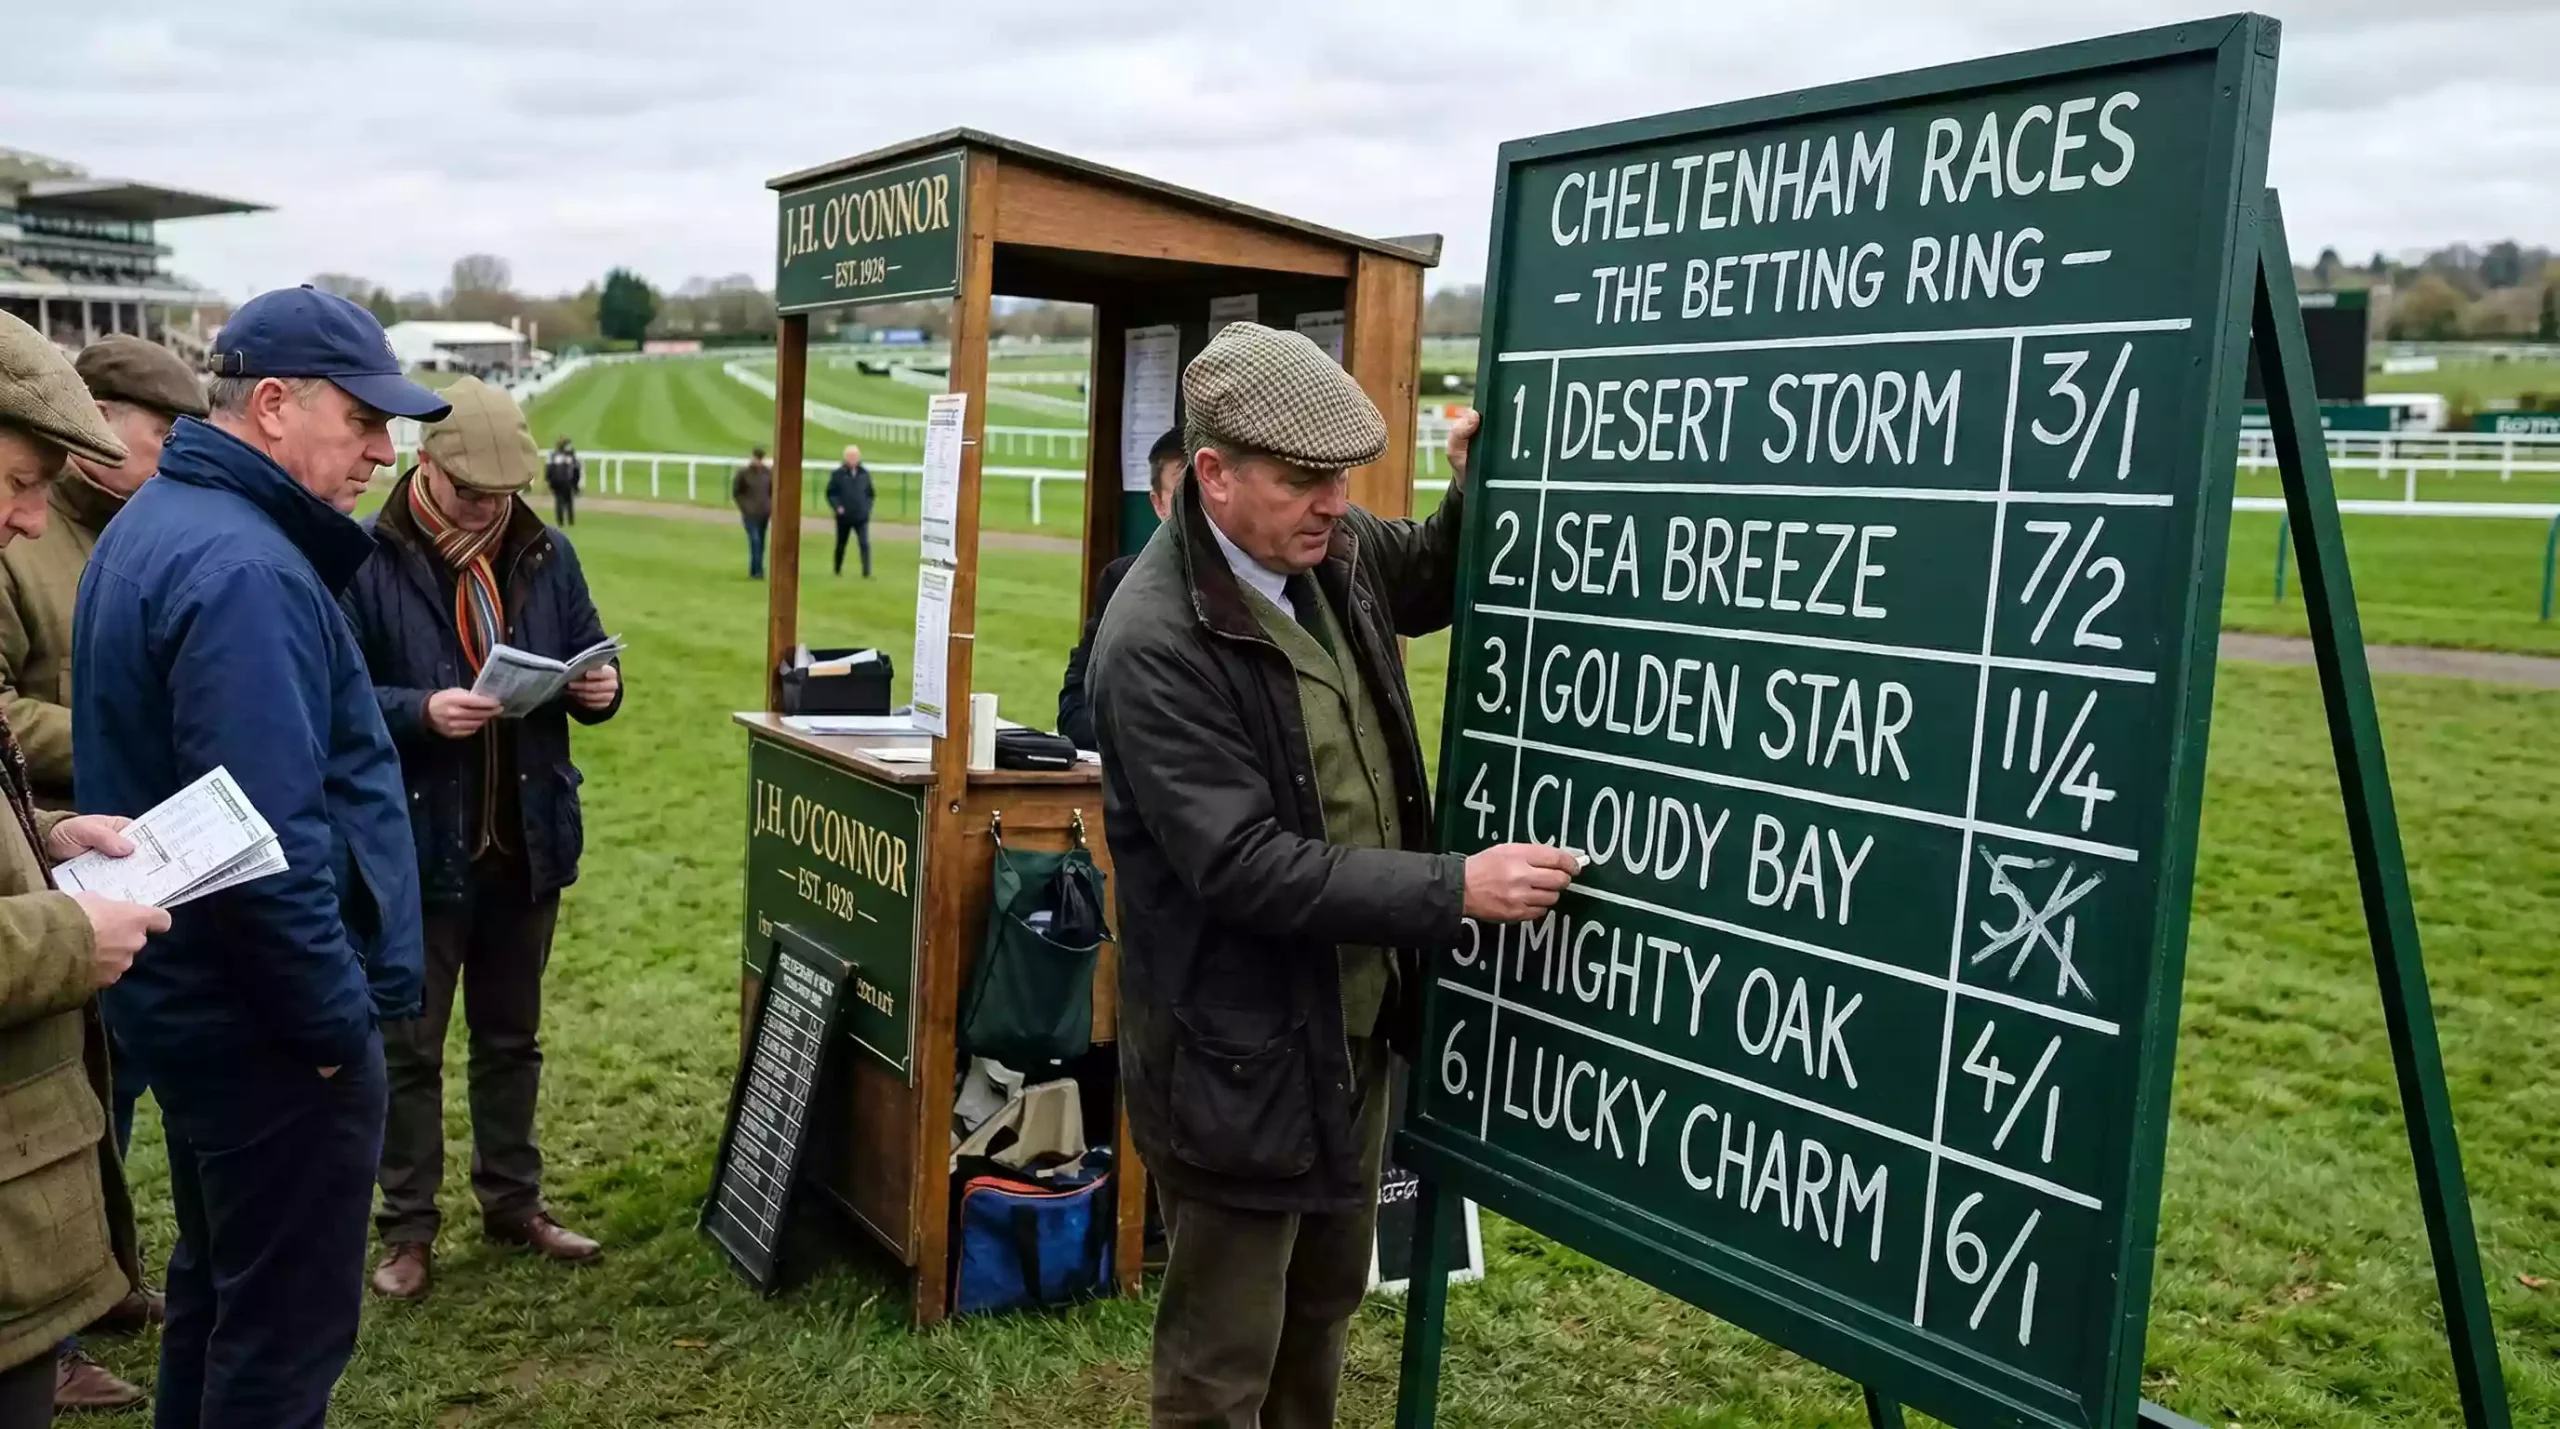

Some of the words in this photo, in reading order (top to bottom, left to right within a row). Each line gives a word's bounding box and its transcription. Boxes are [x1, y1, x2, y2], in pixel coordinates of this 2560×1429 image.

[784, 203, 819, 268] J.H.
[823, 173, 951, 251] O'CONNOR
[1551, 126, 1895, 247] CHELTENHAM
[1919, 91, 2141, 207] RACES
[834, 259, 858, 289] EST.
[860, 256, 885, 286] 1928
[1592, 262, 1668, 325] THE
[1681, 242, 1885, 319] BETTING
[1906, 227, 2045, 305] RING
[1510, 384, 1531, 460] 1.
[1560, 373, 1749, 464] DESERT
[1761, 369, 1962, 466] STORM
[2031, 341, 2140, 481] 3/1
[1488, 510, 1525, 588] 2.
[1551, 511, 1640, 599] SEA
[1662, 516, 1898, 619] BREEZE
[2020, 515, 2126, 650] 7/2
[1476, 636, 1512, 715] 3.
[1540, 644, 1740, 750] GOLDEN
[1759, 668, 1913, 782] STAR
[2002, 687, 2117, 832] 11/4
[754, 778, 785, 839] J.H.
[789, 793, 909, 898] O'CONNOR
[798, 867, 823, 906] EST.
[826, 881, 854, 922] 1928
[1463, 762, 1499, 841] 4.
[1527, 773, 1731, 890] CLOUDY
[1747, 813, 1875, 926] BAY
[1514, 909, 1721, 1038] MIGHTY
[1736, 967, 1863, 1089] OAK
[1441, 1019, 1475, 1102] 6.
[1503, 1036, 1667, 1167] LUCKY
[1680, 1103, 1888, 1263] CHARM
[1961, 1020, 2062, 1164] 4/1
[1945, 1191, 2041, 1347] 6/1
